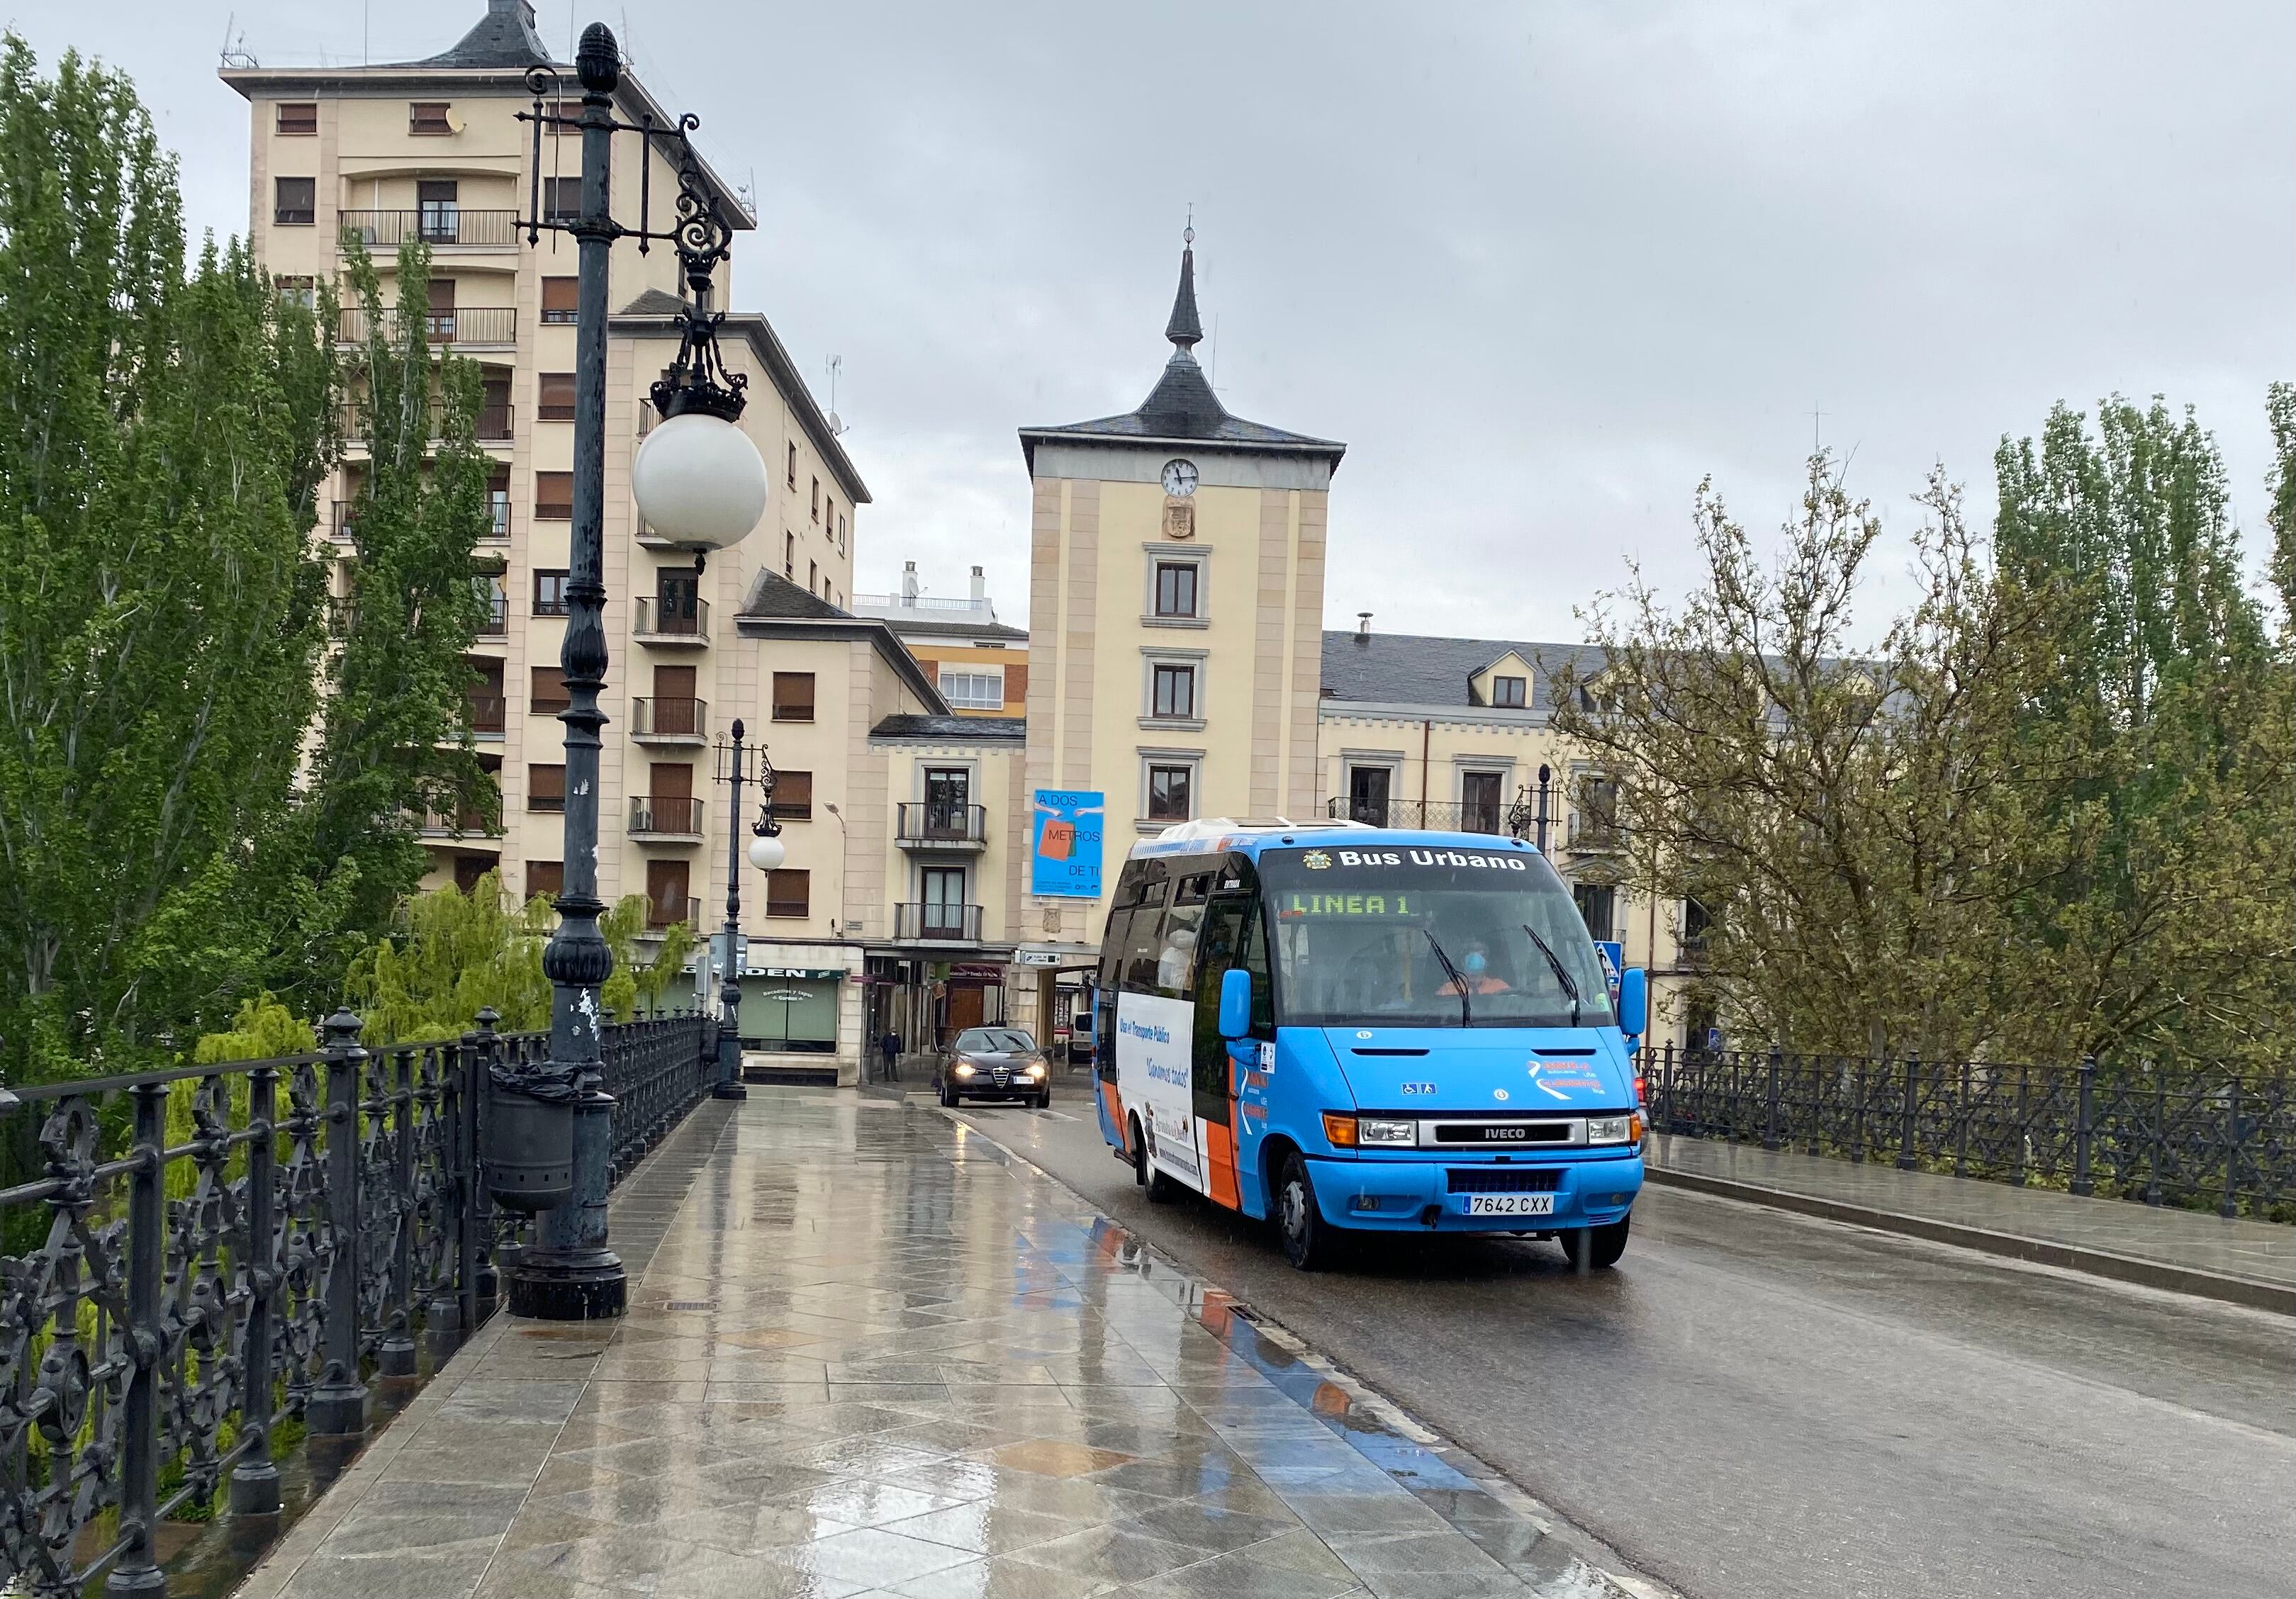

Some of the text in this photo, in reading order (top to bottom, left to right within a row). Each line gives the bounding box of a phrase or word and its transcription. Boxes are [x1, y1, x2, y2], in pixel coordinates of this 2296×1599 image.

[1038, 795, 1077, 806] A DOS
[1049, 830, 1099, 842] METROS
[1338, 850, 1526, 870] Bus Urbano
[1069, 865, 1099, 877] DE TI
[1293, 894, 1409, 914] LINEA 1
[681, 965, 806, 978] GDEN
[1485, 1128, 1525, 1138] IVECO
[1474, 1198, 1550, 1212] 7642 CXX
